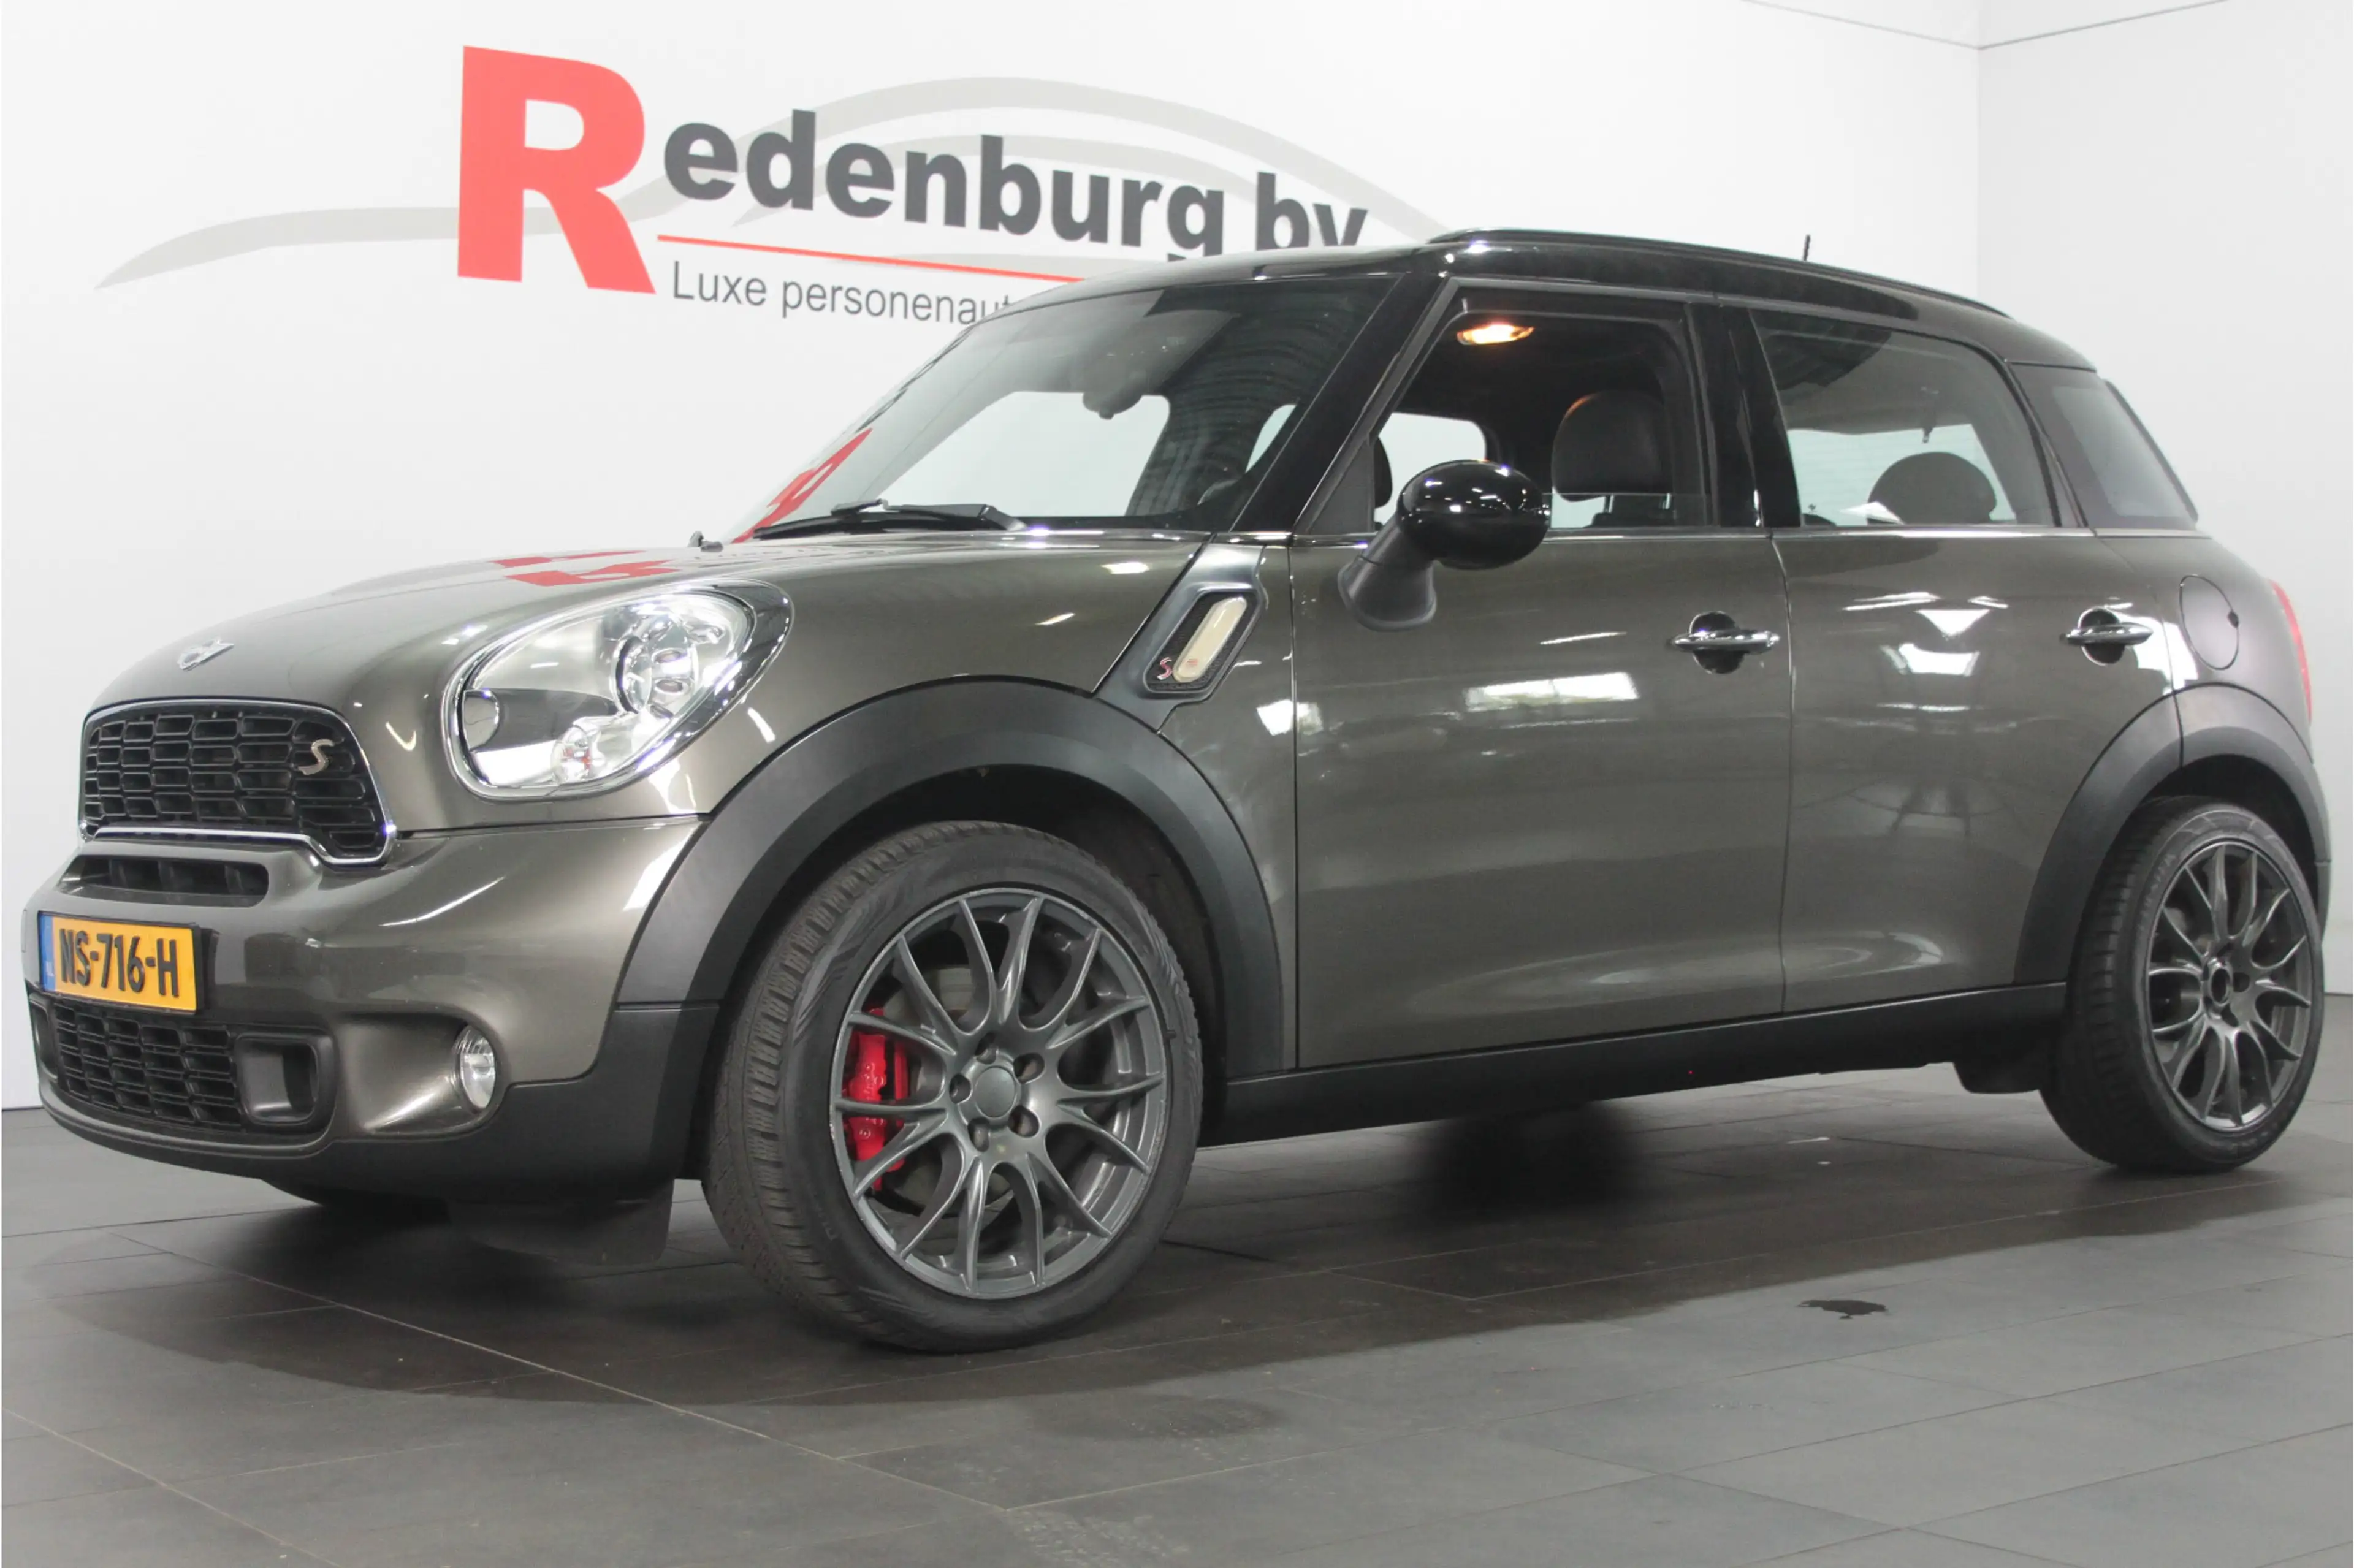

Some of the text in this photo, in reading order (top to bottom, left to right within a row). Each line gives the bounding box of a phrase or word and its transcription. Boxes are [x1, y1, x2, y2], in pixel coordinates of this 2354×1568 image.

[457, 45, 1224, 294] Redenburg
[674, 261, 767, 306] Luxe
[1157, 657, 1172, 680] S
[298, 739, 334, 775] S
[59, 928, 179, 997] NS-716-H
